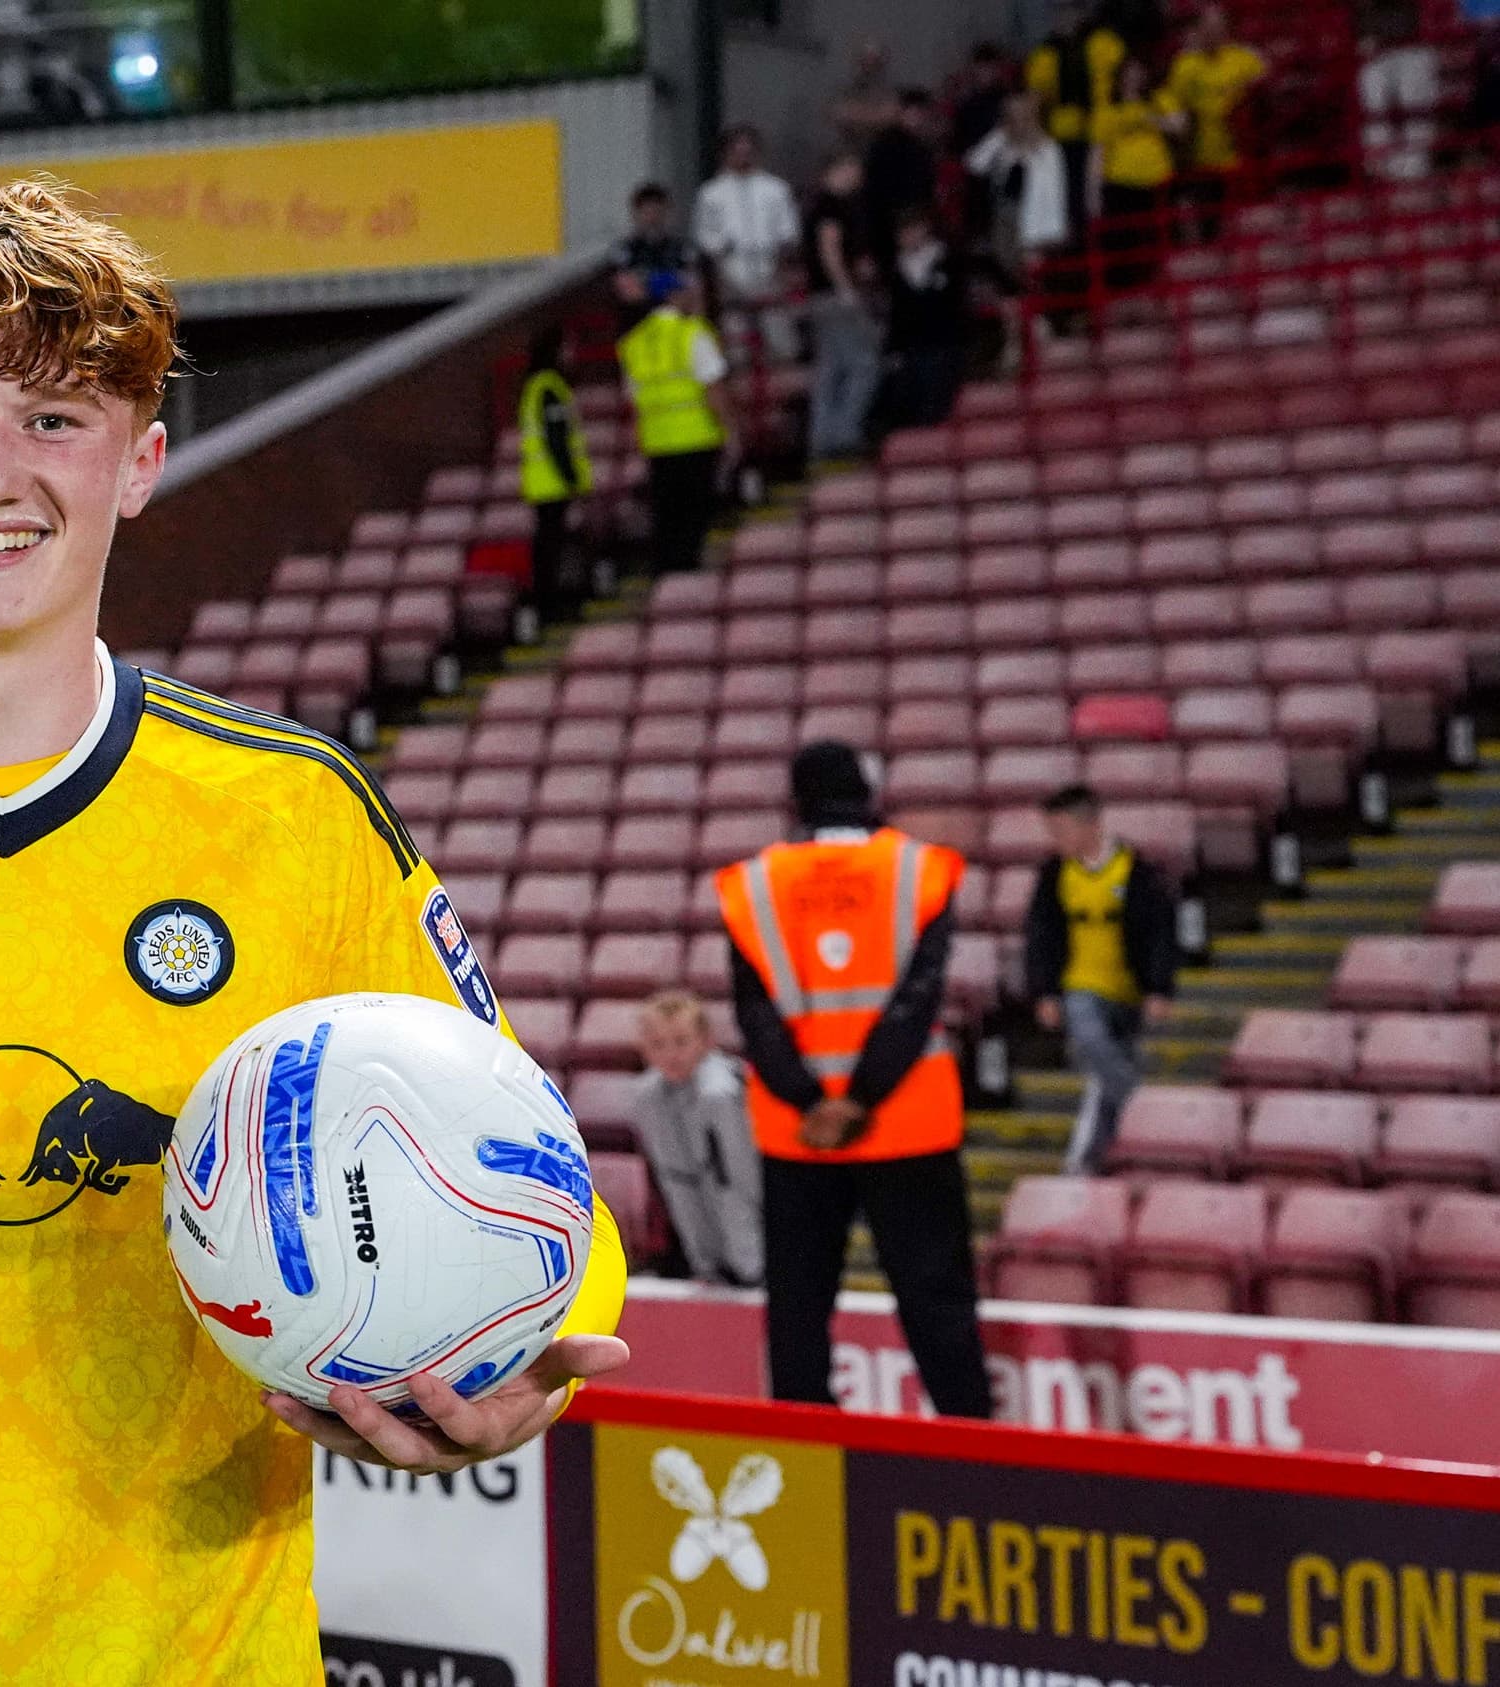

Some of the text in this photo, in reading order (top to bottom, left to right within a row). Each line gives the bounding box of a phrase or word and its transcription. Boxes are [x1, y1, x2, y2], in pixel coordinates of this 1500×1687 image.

[148, 924, 210, 969] LEEDS UNITED
[166, 971, 194, 983] AFC
[179, 1204, 207, 1249] PUMA
[895, 1510, 1208, 1655] PARTIES
[617, 1575, 822, 1678] Oakwell
